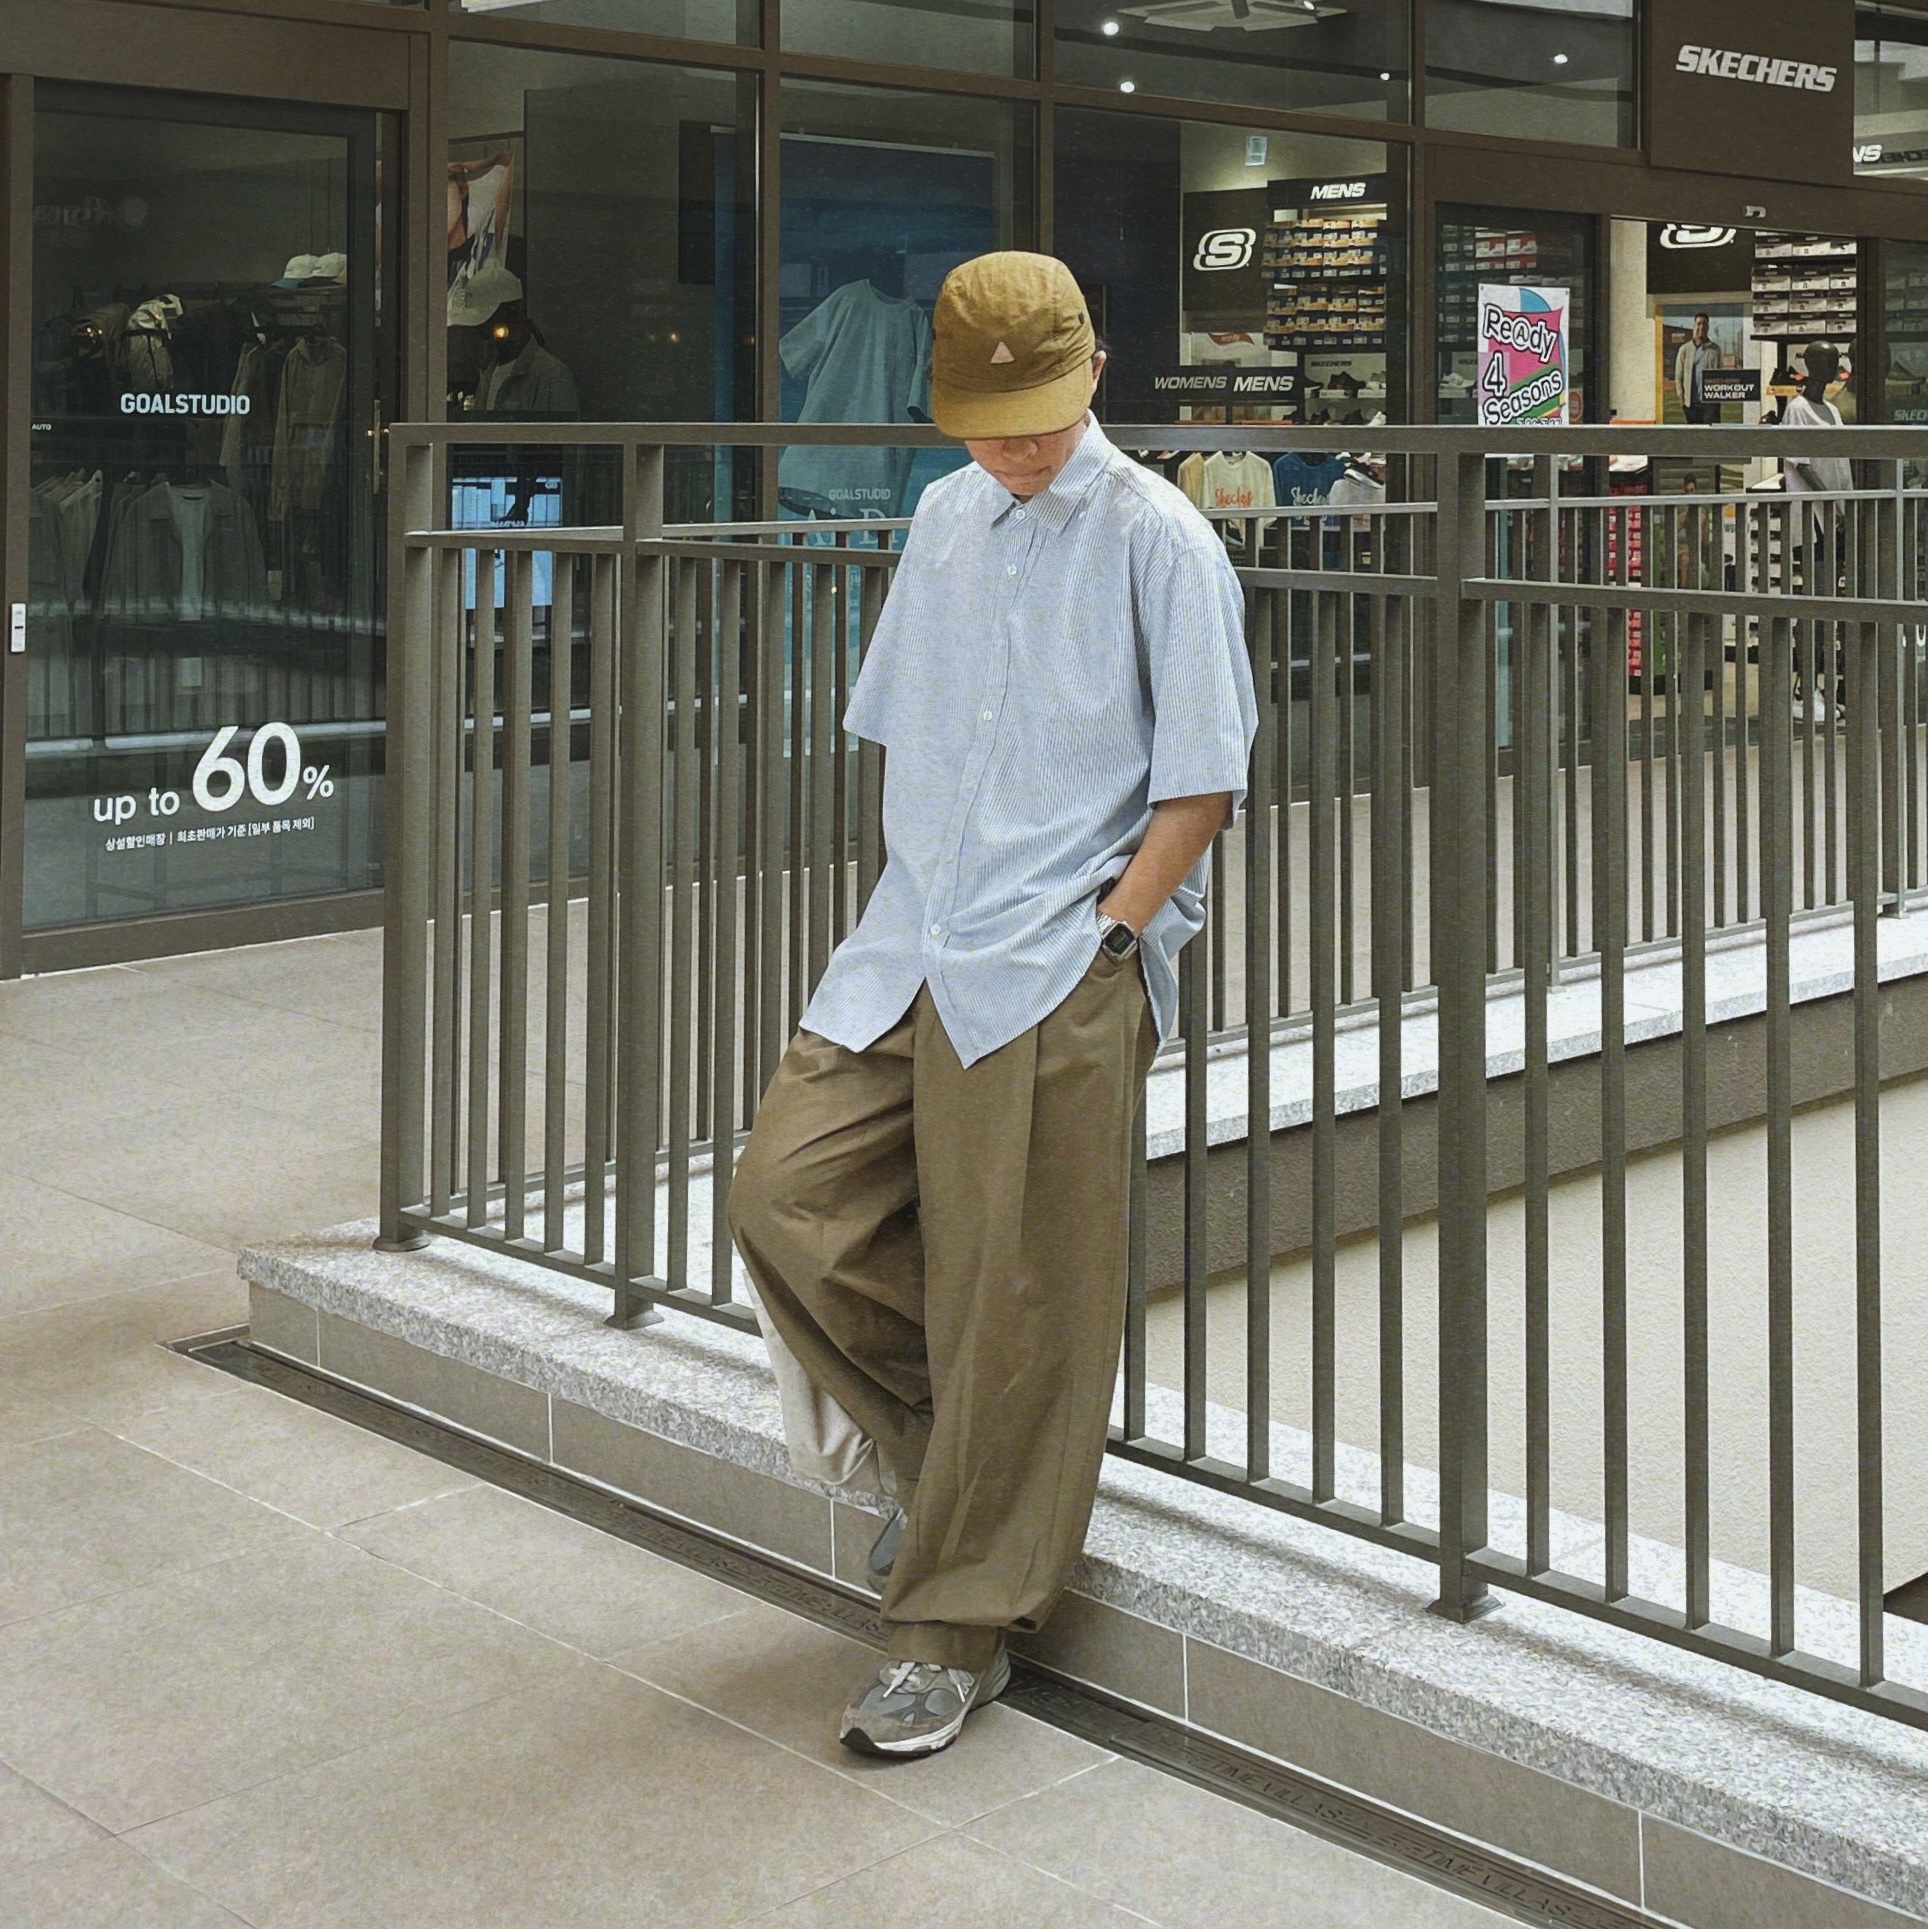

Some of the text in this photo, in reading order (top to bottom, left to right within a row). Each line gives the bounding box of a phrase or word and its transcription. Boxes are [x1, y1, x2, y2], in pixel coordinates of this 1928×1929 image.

[1675, 44, 1837, 93] SKECHERS
[1310, 182, 1366, 200] MENS
[1154, 376, 1295, 392] WOMENS MENS
[1484, 353, 1506, 396] 4
[120, 393, 251, 415] GOALSTUDIO
[1484, 371, 1563, 424] Seasons
[1704, 391, 1746, 399] WALKER
[31, 423, 52, 431] AUTO
[828, 488, 892, 501] GOALSTUDIO
[93, 721, 335, 826] up to 60%
[105, 832, 166, 852] 상설할인매장
[227, 824, 247, 838] 기준
